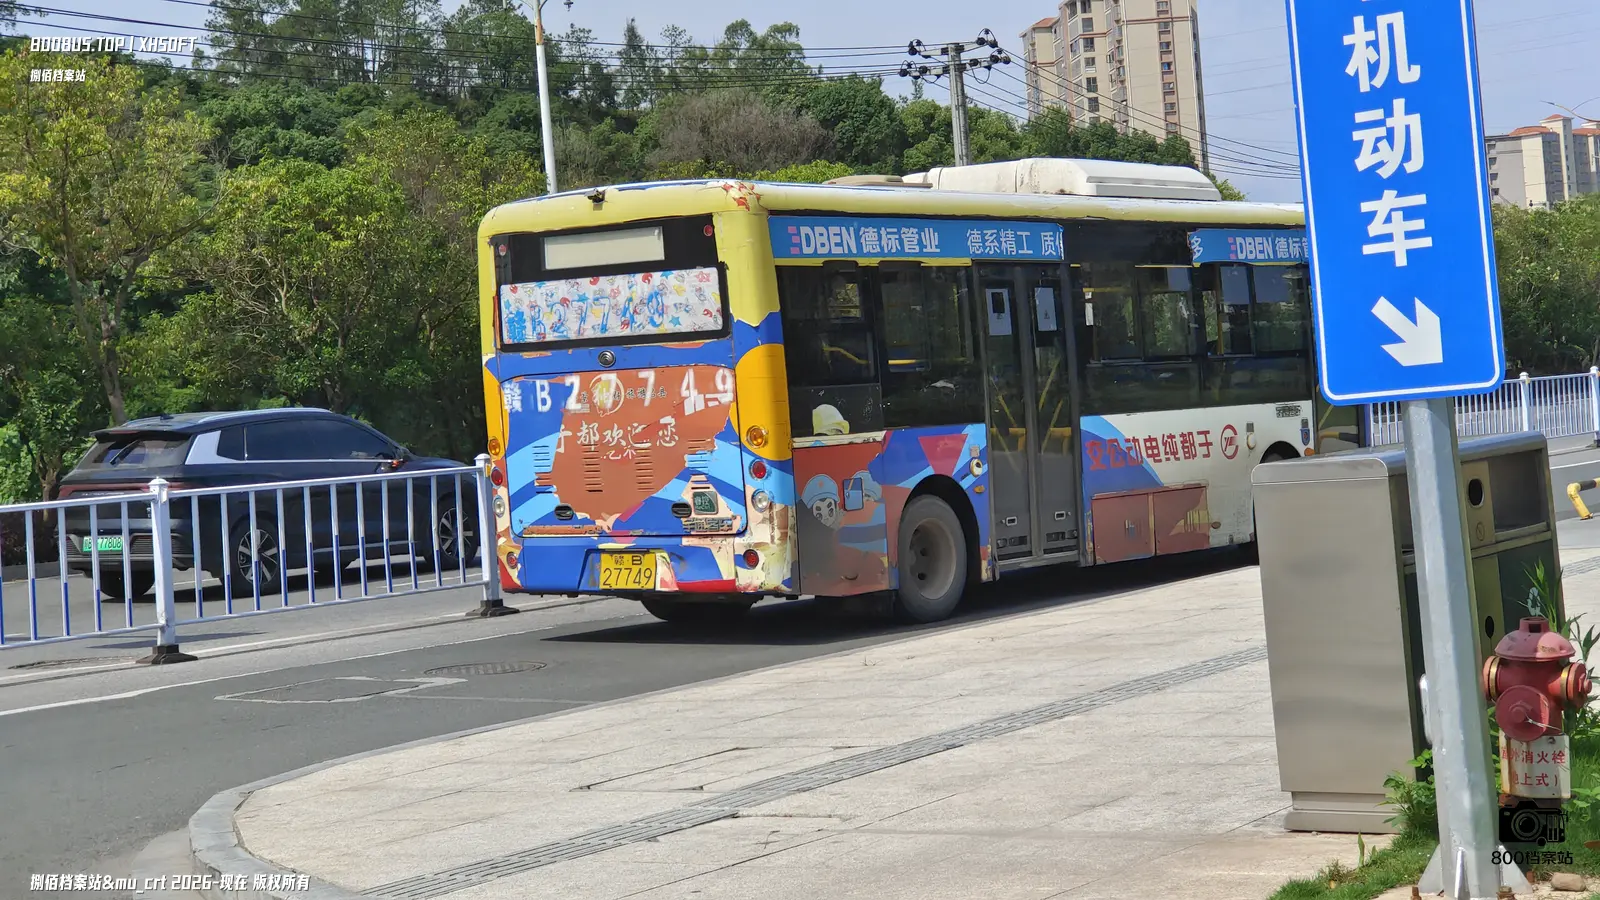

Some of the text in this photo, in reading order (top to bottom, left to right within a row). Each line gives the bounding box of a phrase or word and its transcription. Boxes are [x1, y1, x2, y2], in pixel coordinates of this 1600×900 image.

[1342, 10, 1433, 268] 机动车
[860, 226, 940, 254] 德标管业
[967, 228, 1034, 256] 德系精工
[602, 567, 653, 587] 27749
